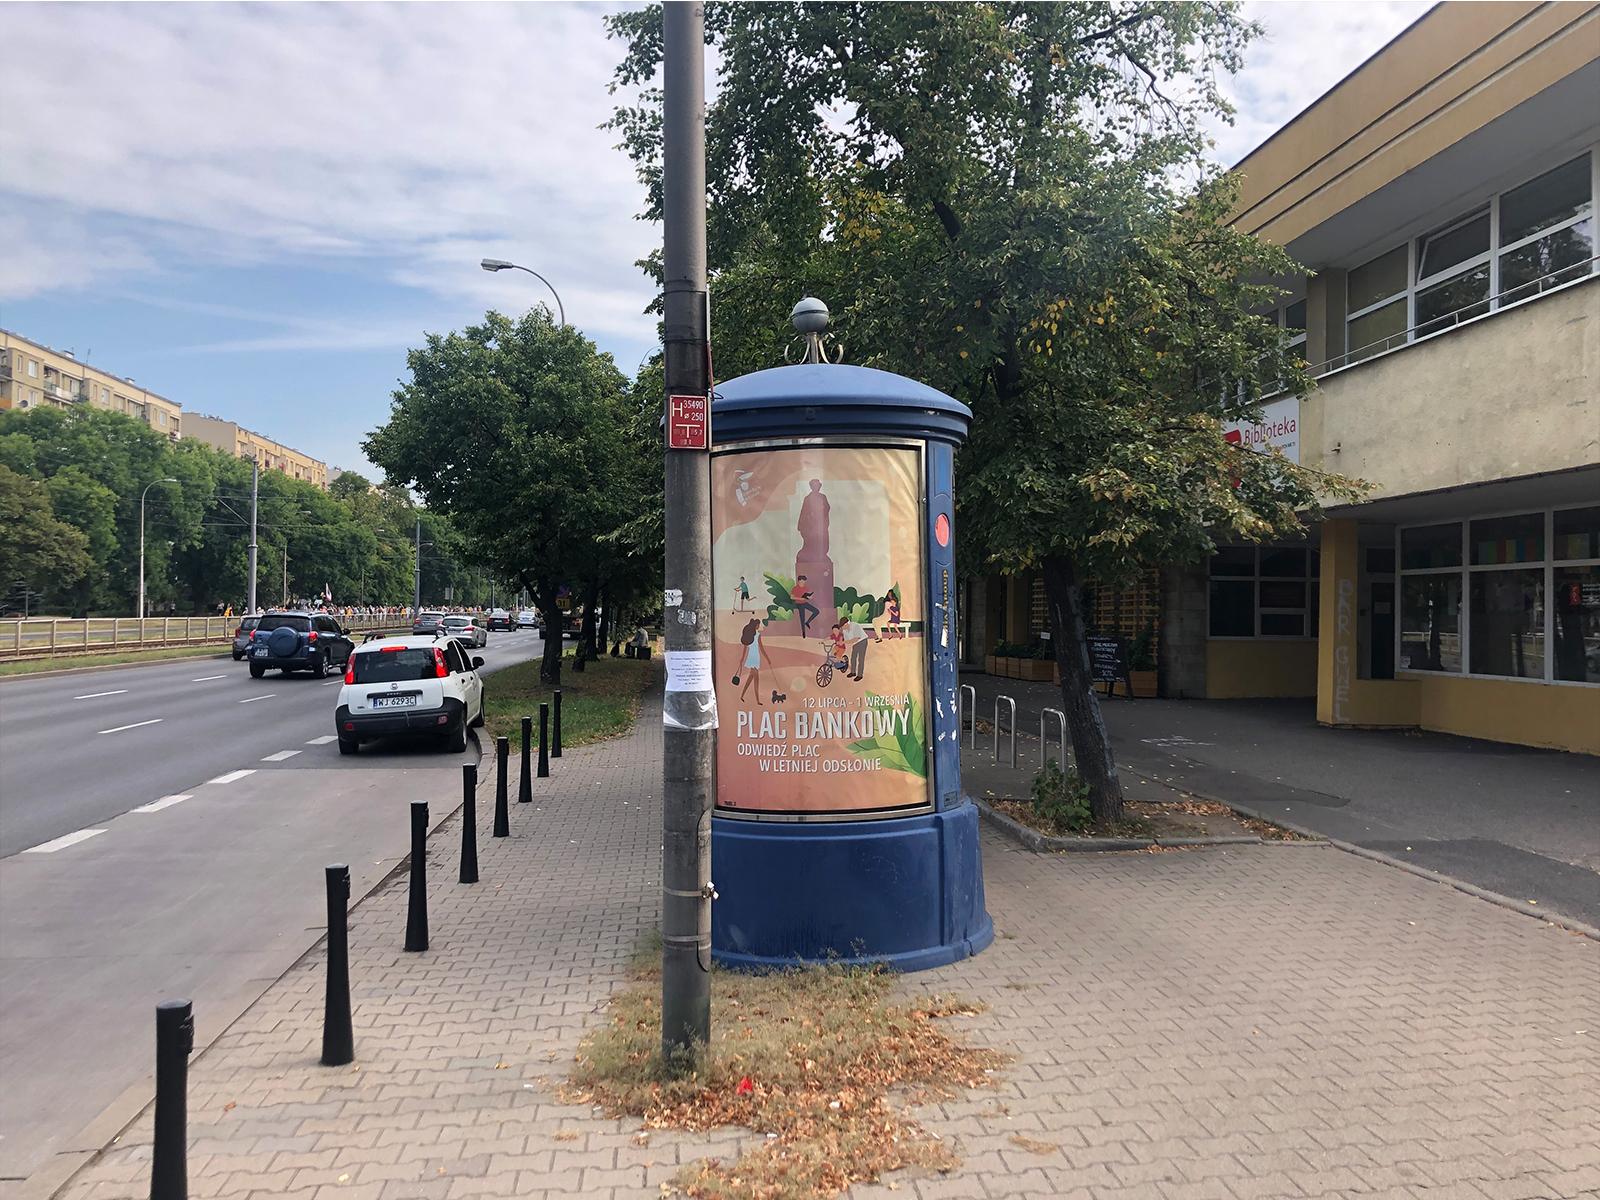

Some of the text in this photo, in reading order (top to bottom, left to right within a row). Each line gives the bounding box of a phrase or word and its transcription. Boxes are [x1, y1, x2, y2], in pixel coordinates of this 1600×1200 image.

[672, 400, 704, 417] H 35490
[691, 412, 704, 421] 250
[802, 697, 815, 708] 12
[818, 697, 847, 708] LIPCA
[856, 697, 861, 707] 1
[737, 707, 911, 739] PLAC BANKOWY
[737, 742, 821, 757] ODWIEDŹ PLAC
[760, 757, 882, 773] W LETNIEJ ODSŁONIE
